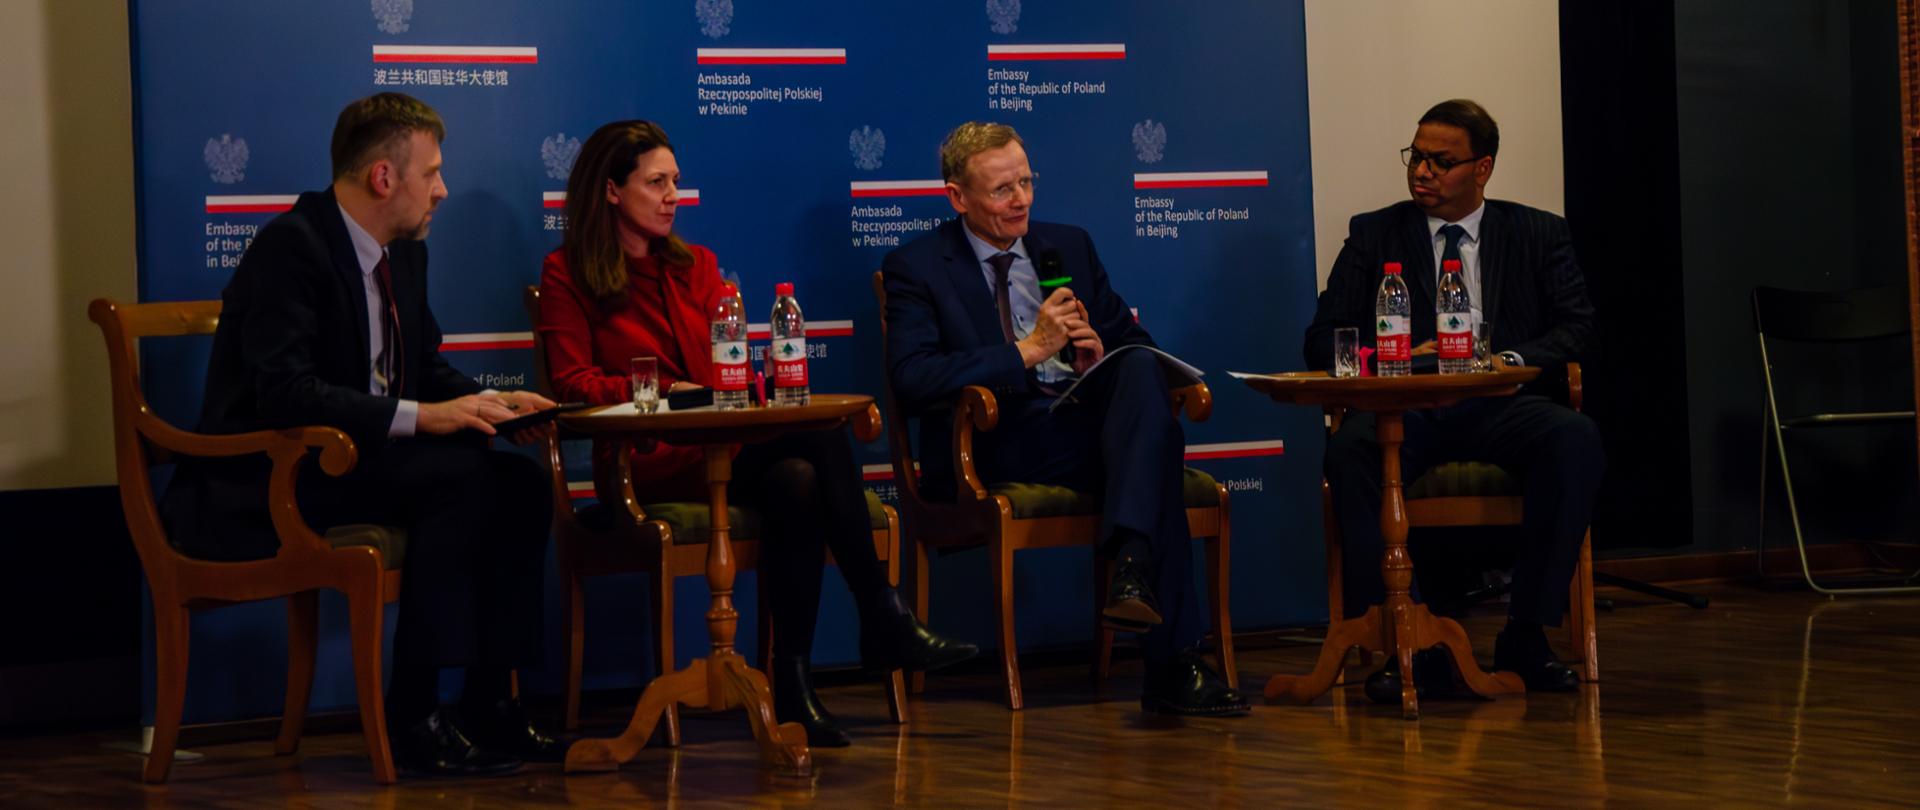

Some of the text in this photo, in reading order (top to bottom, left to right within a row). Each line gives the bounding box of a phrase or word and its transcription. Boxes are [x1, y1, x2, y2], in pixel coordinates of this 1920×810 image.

[374, 68, 509, 86] 波兰共和国驻华大使馆
[698, 72, 752, 85] Ambasada
[988, 68, 1029, 82] Embassy
[698, 86, 823, 102] Rzeczypospolitej Polskiej
[988, 81, 1106, 96] of the Republic of Poland
[698, 102, 748, 115] w Pekinie
[989, 97, 1033, 112] in Beijing
[1134, 196, 1175, 209] Embassy
[851, 204, 903, 218] Ambasada
[1135, 207, 1249, 224] of the Republic of Poland
[206, 222, 258, 238] Embassy
[851, 218, 933, 234] Rzeczypospolitej
[1136, 223, 1179, 239] in Beijing
[206, 238, 219, 252] of
[222, 238, 242, 252] the
[851, 234, 900, 247] w Pekinie
[206, 254, 218, 268] in
[486, 373, 525, 387] Poland
[1227, 477, 1263, 492] Polskiej
